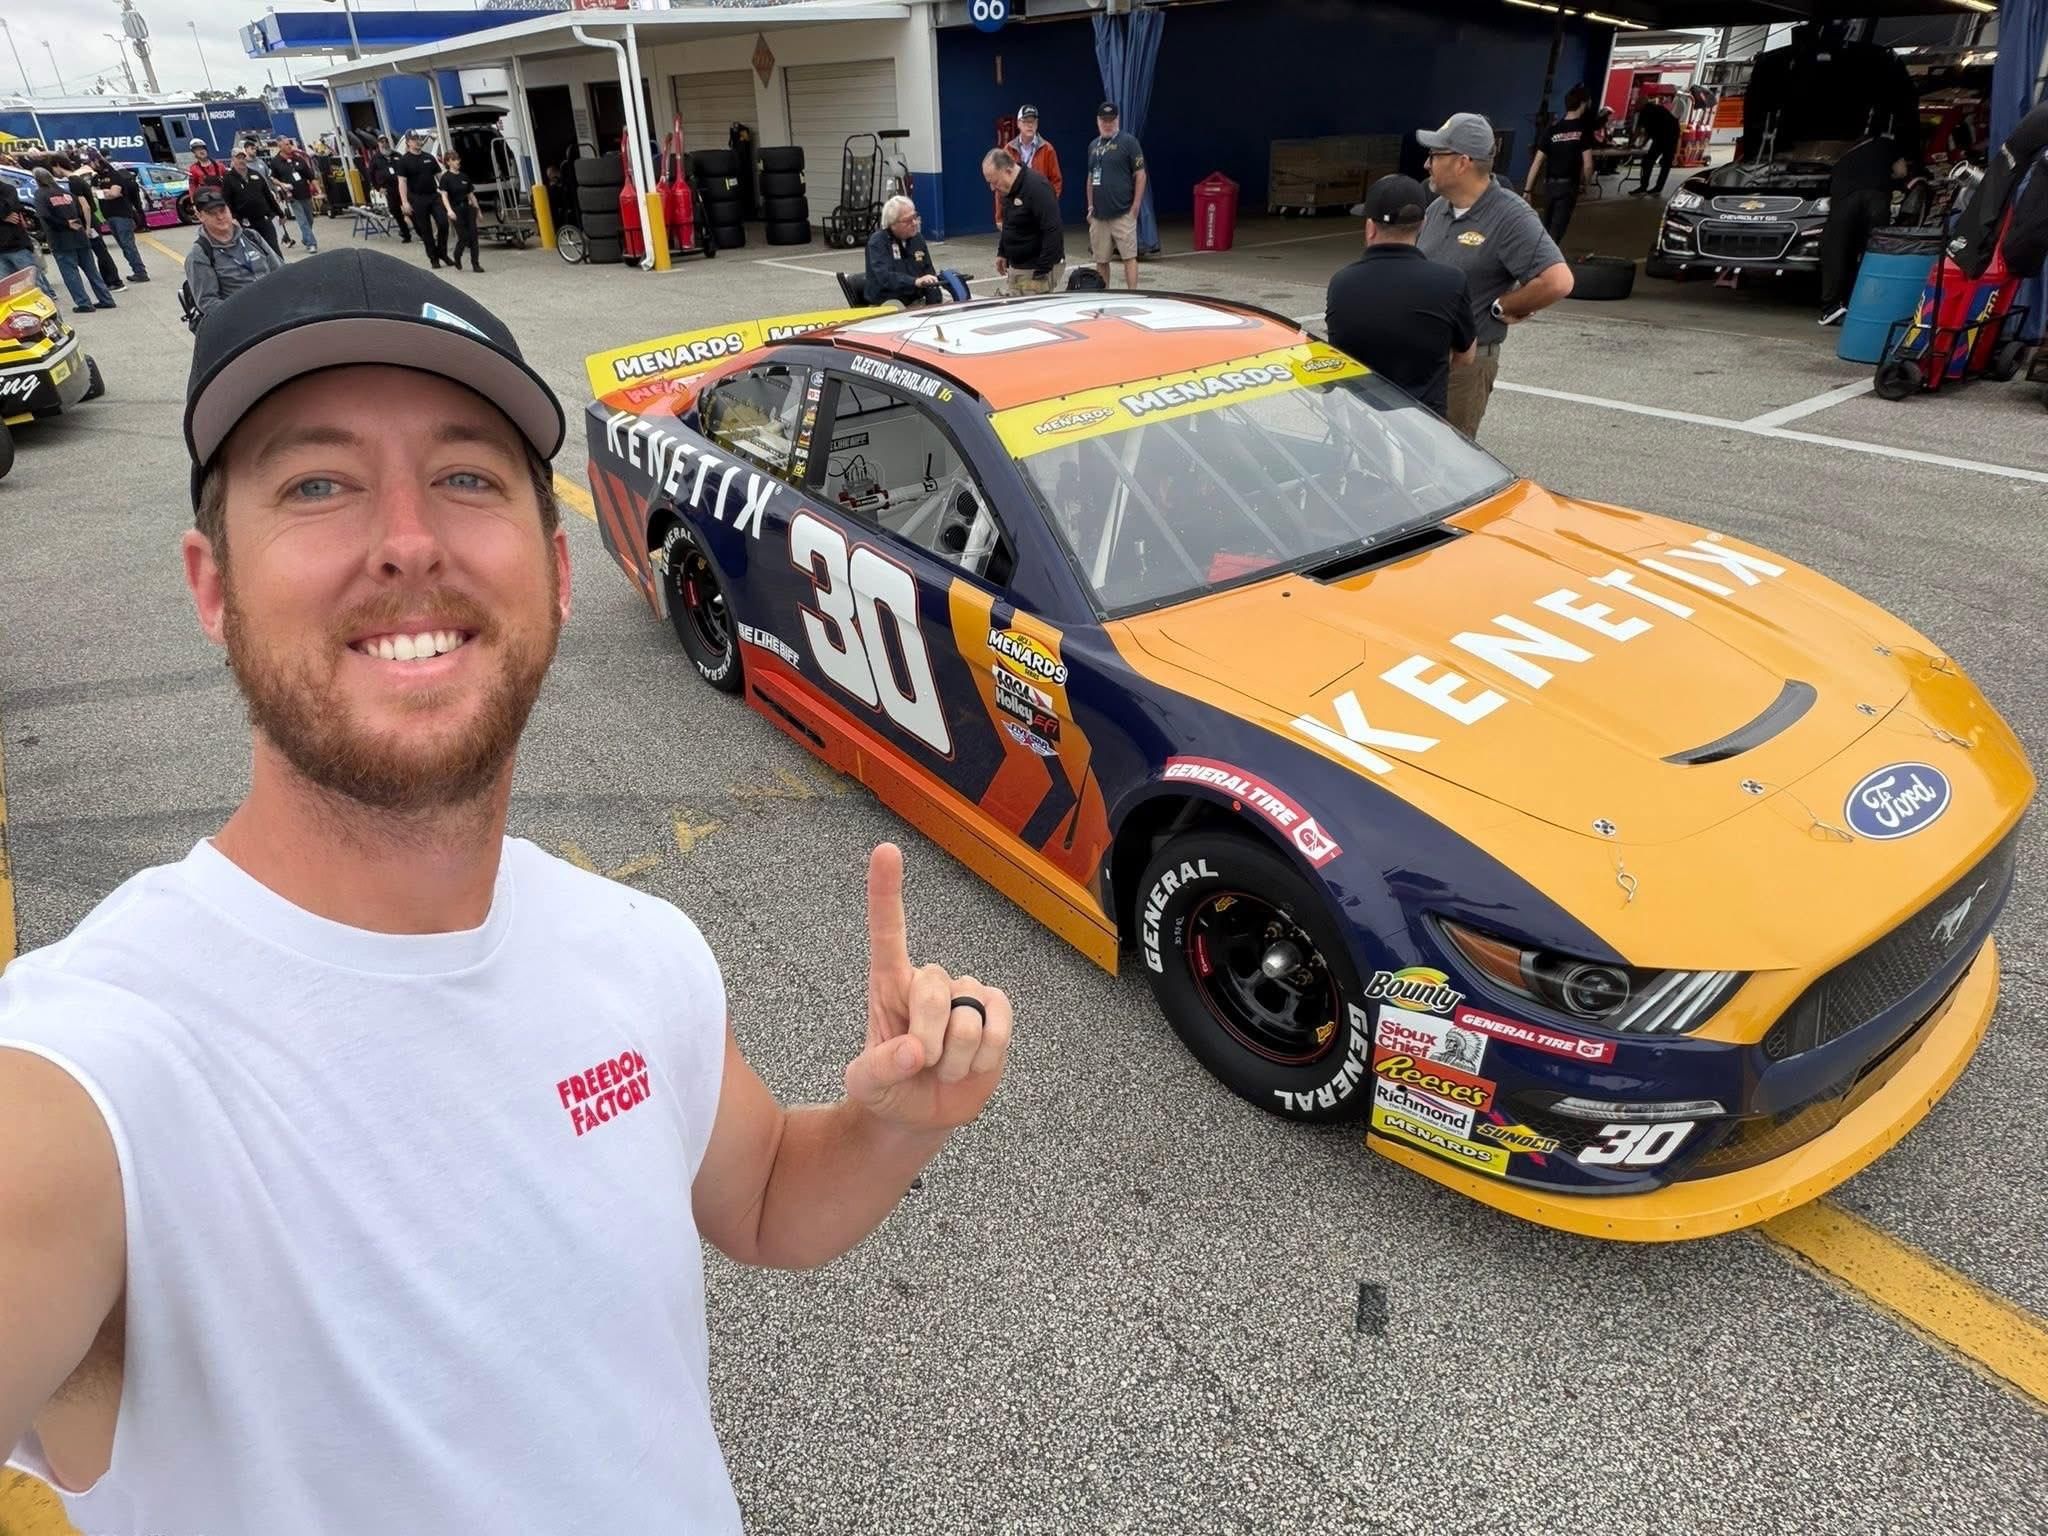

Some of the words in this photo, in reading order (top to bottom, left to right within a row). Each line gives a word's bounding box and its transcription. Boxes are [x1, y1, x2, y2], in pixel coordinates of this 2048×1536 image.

[974, 0, 1005, 20] 66
[99, 135, 144, 149] FUELS
[1719, 213, 1764, 221] CHEVROLET
[613, 332, 745, 382] MENARDS
[850, 355, 890, 380] CLEETUS
[938, 387, 955, 402] 16
[1120, 363, 1295, 416] MENARDS
[1034, 407, 1115, 434] MENARDS
[662, 527, 695, 576] GENERAL
[789, 510, 953, 757] 30
[988, 629, 1066, 684] MENARDS
[995, 686, 1033, 726] Holley
[1164, 763, 1252, 796] GENERAL
[1247, 786, 1300, 827] TIRE
[1862, 773, 1937, 828] Ford
[1143, 859, 1219, 973] GENERAL
[1364, 970, 1461, 1013] Bounty
[1378, 1034, 1431, 1058] Chief
[1380, 1019, 1438, 1046] Sioux
[1461, 1013, 1536, 1042] GENERAL
[1536, 1034, 1577, 1052] TIRE
[1274, 1002, 1370, 1112] GENERAL
[570, 1071, 651, 1136] FACTORY
[1377, 1085, 1468, 1130] Richmond
[1385, 1115, 1492, 1162] MENARDS
[1477, 1123, 1560, 1153] SUNOCO
[1577, 1121, 1695, 1165] 30
